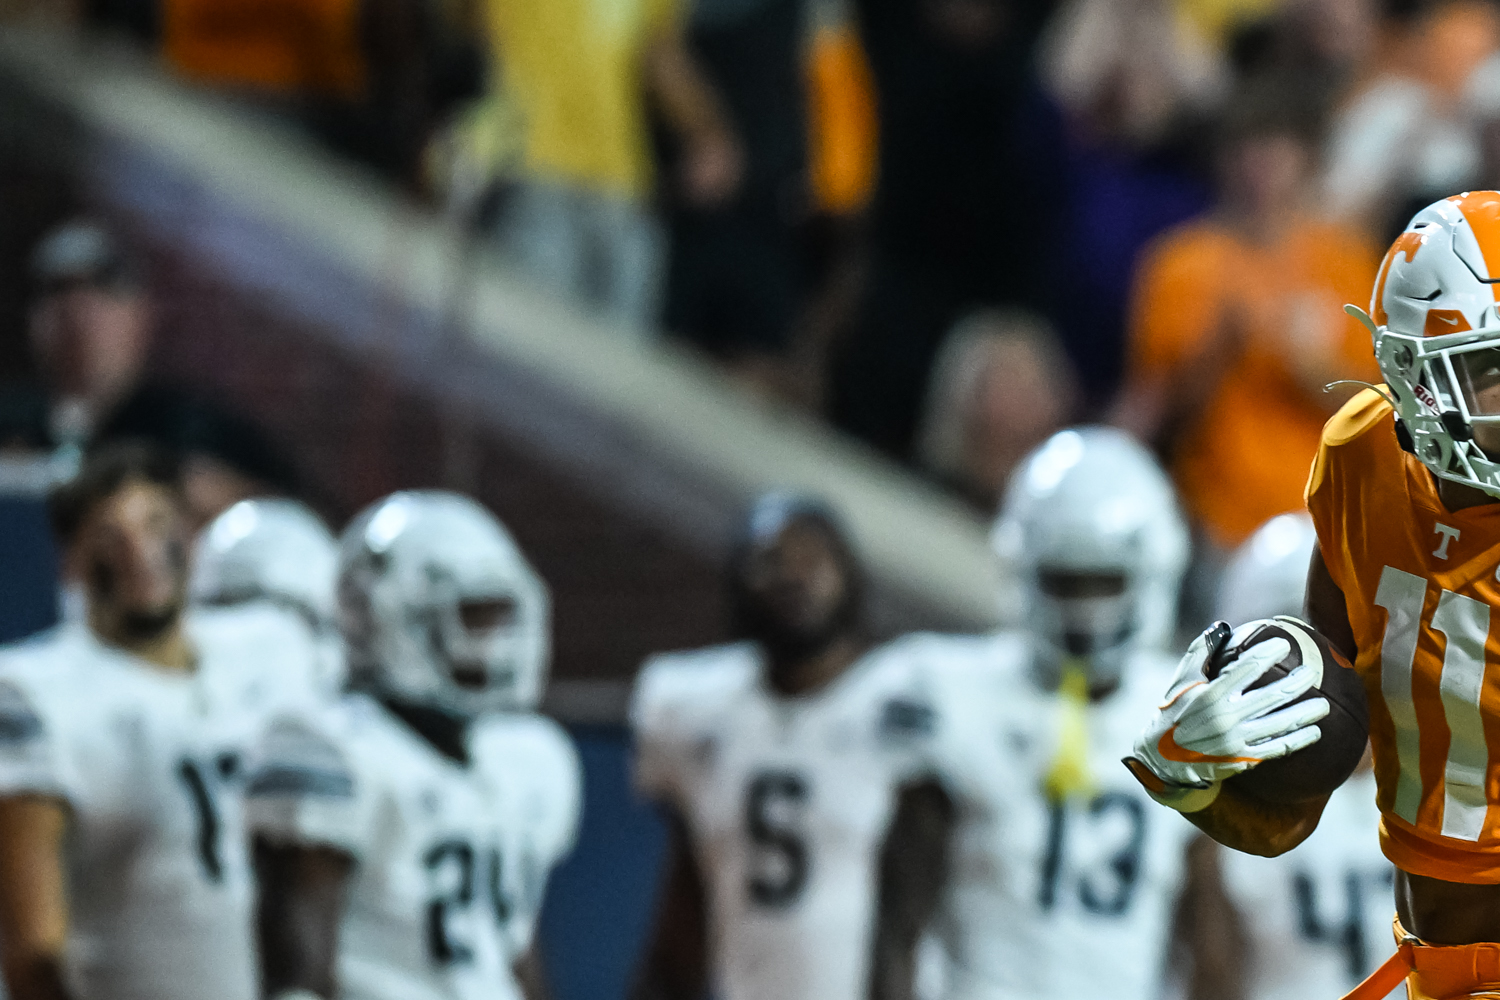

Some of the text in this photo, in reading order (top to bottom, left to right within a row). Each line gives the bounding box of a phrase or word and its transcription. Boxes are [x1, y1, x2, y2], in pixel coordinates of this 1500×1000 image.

[1432, 522, 1461, 561] T
[1374, 564, 1491, 843] 11
[1038, 788, 1146, 918] 13
